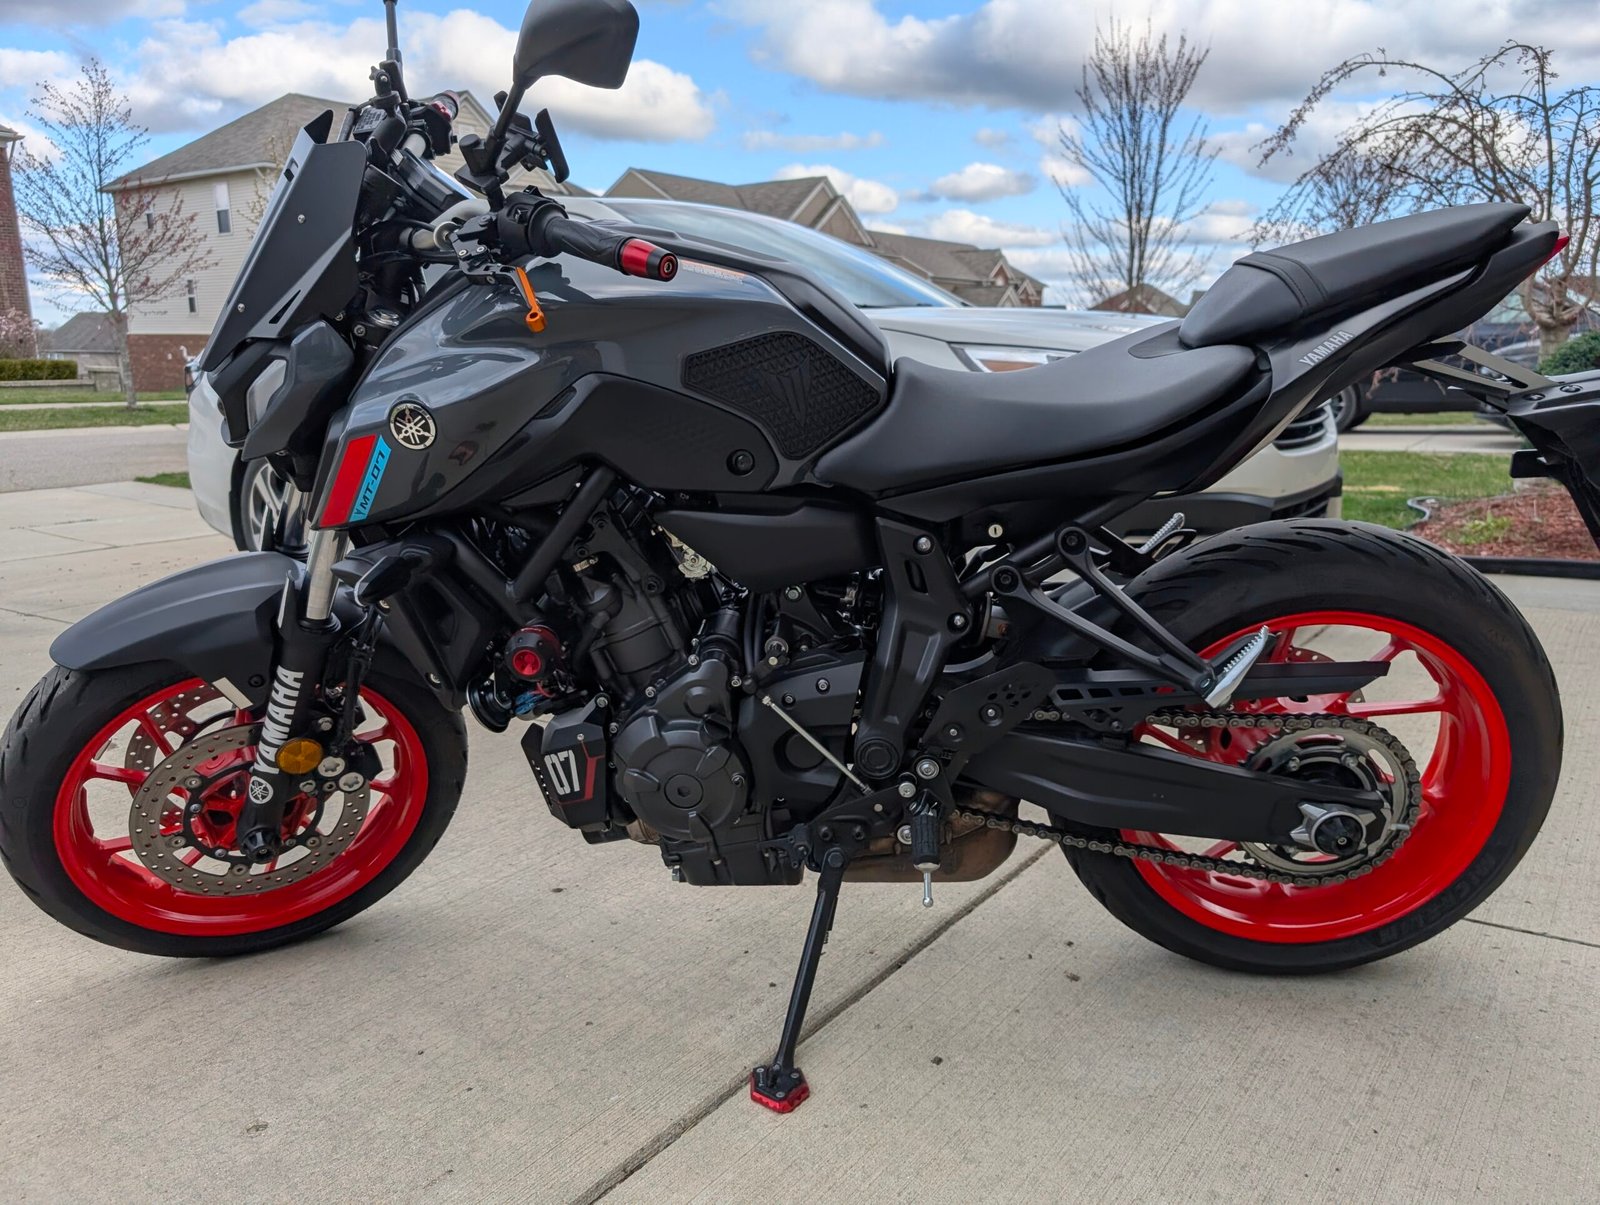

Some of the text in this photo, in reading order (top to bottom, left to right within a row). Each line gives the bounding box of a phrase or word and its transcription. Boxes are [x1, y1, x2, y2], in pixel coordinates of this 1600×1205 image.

[1299, 331, 1354, 366] YAMAHA
[360, 449, 386, 510] MT-07
[251, 665, 304, 774] YAMAHA
[544, 749, 580, 795] 07
